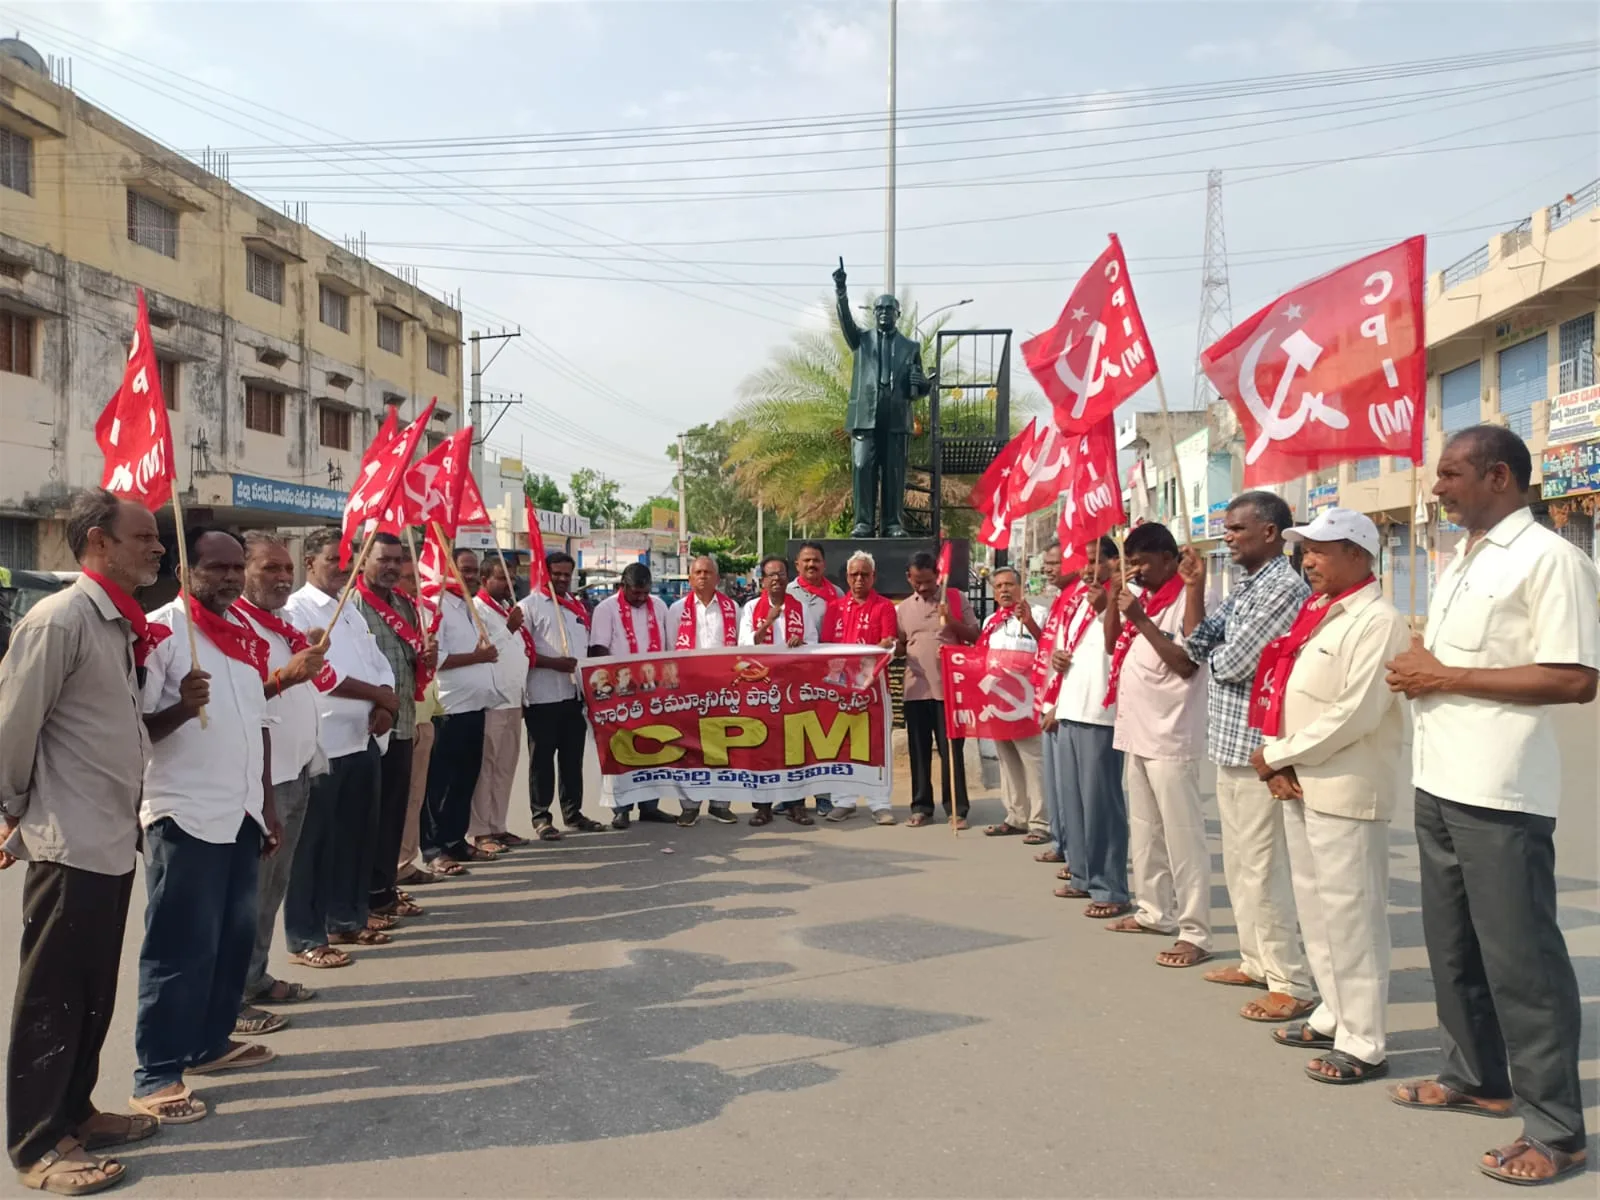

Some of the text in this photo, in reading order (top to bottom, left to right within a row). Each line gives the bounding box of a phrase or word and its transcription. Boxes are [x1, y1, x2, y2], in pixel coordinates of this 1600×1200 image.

[594, 700, 644, 725] భారత
[609, 710, 872, 767] CPM
[632, 768, 711, 786] వనపర్తి
